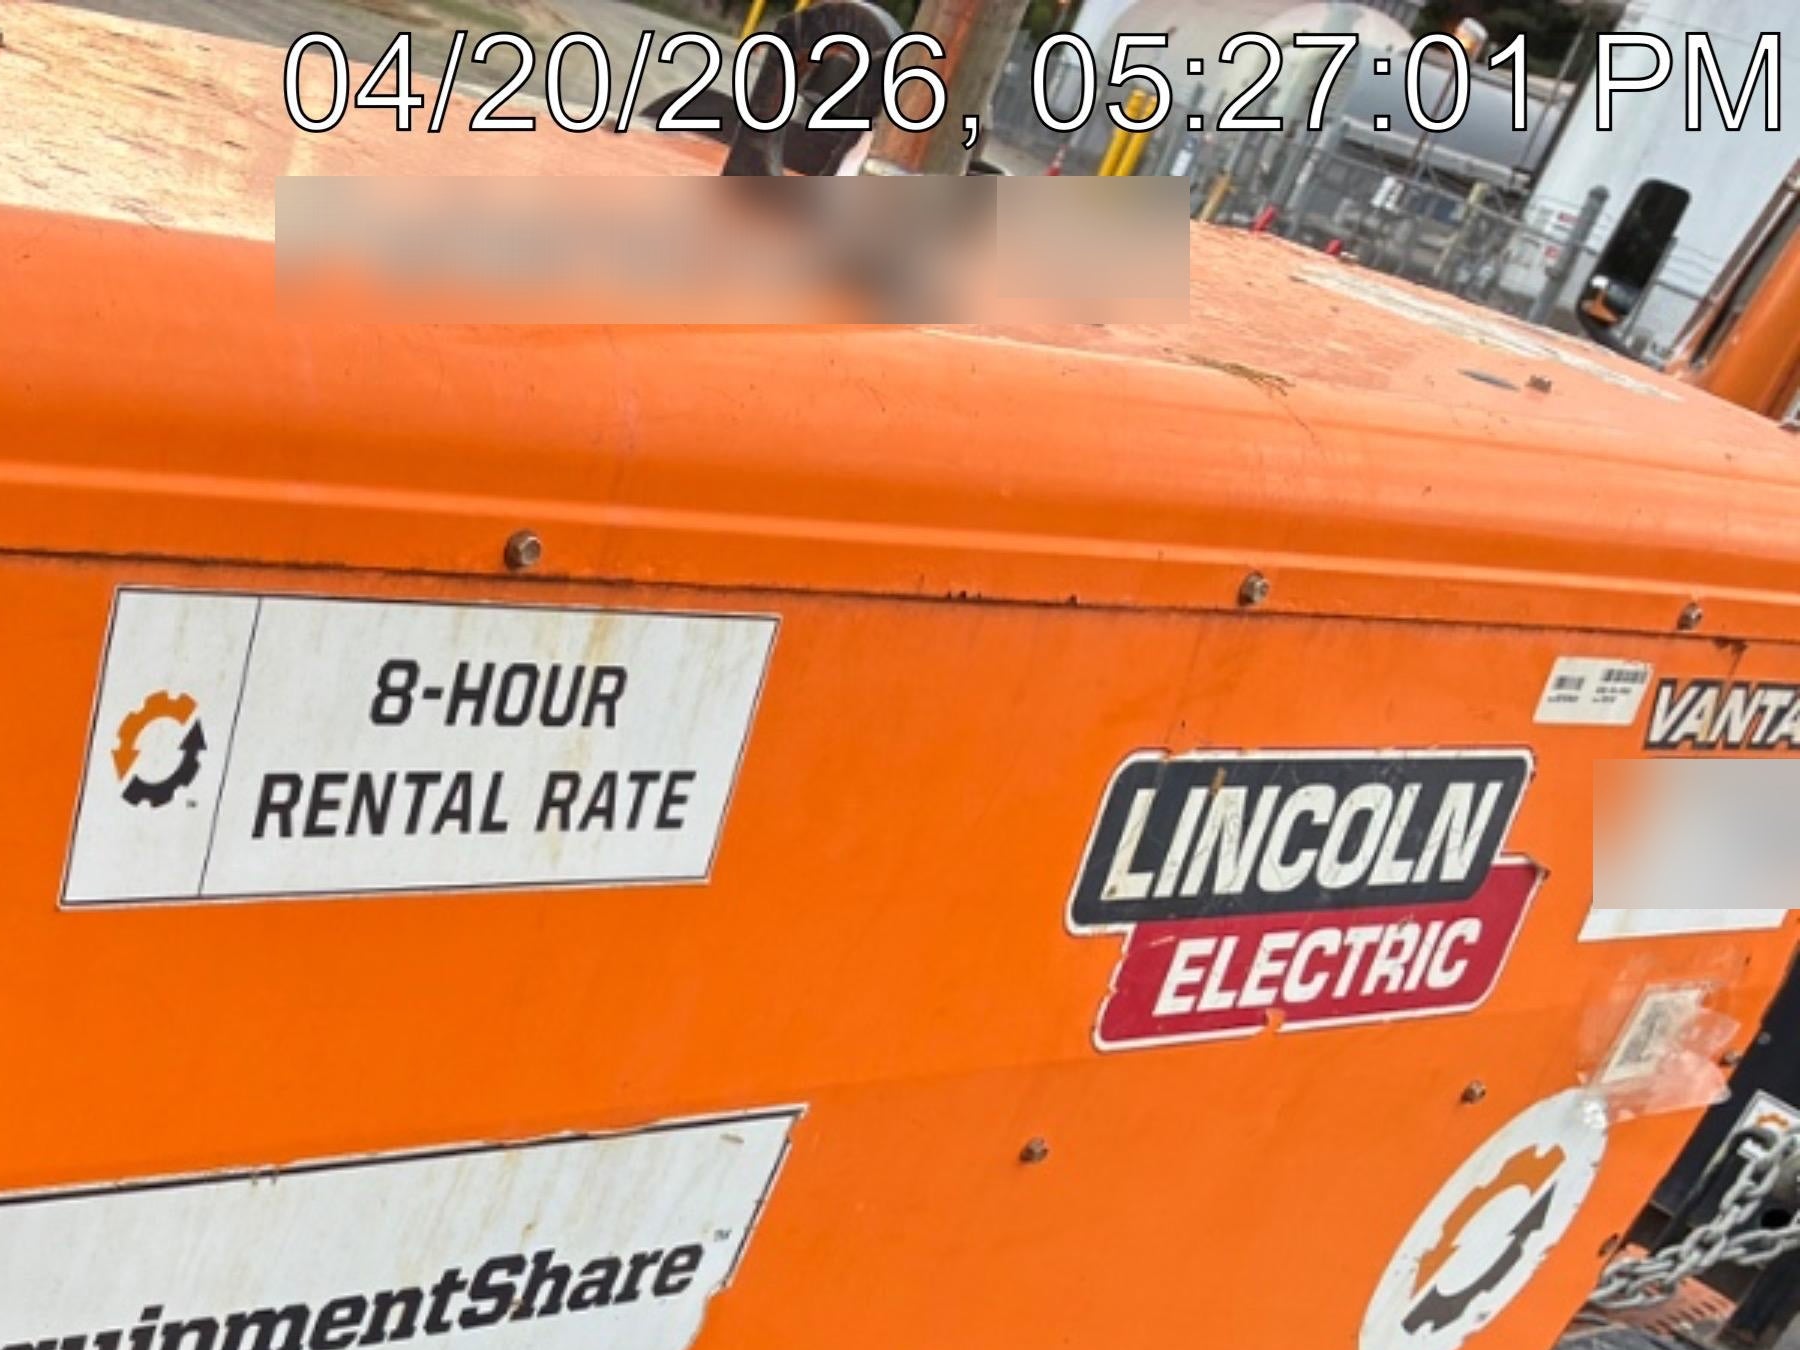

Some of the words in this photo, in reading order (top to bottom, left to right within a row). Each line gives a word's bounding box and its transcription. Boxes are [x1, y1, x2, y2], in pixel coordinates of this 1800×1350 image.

[369, 658, 628, 728] 8-HOUR
[250, 770, 510, 840] RENTAL
[533, 769, 697, 833] RATE
[1100, 779, 1504, 902] LINCOLN
[1152, 916, 1484, 1017] ELECTRIC
